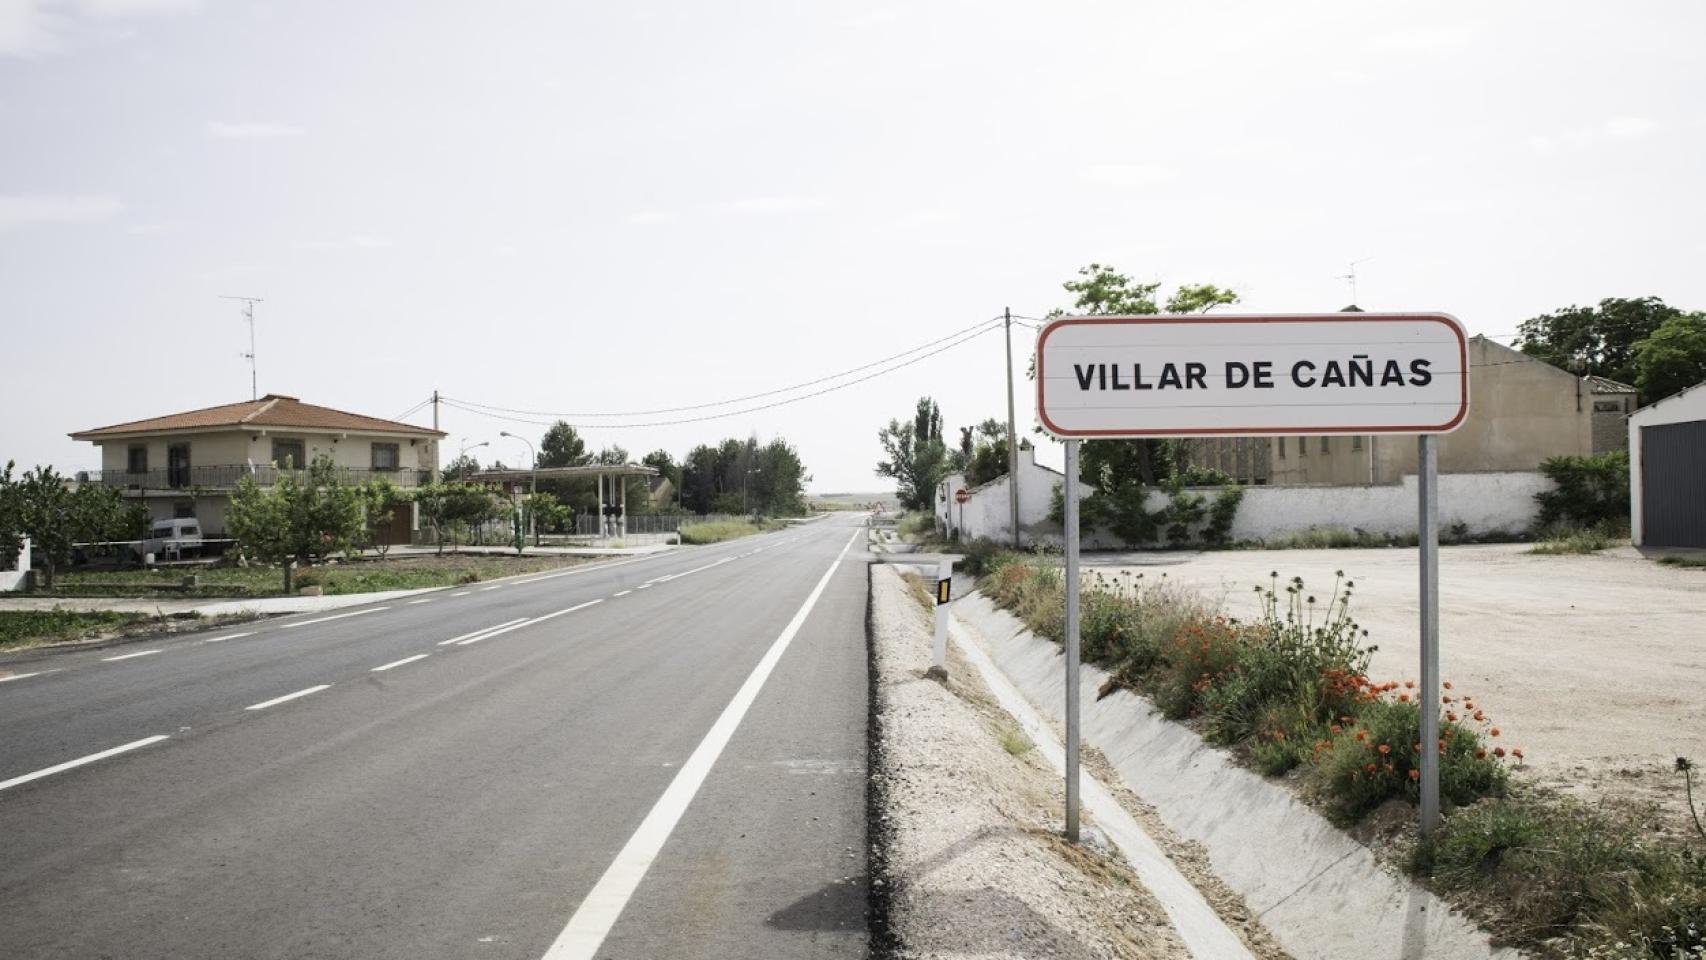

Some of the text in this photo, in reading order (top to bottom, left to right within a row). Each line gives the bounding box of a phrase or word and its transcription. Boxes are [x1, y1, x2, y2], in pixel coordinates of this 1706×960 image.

[1073, 354, 1432, 391] VILLAR DE CAÑAS
